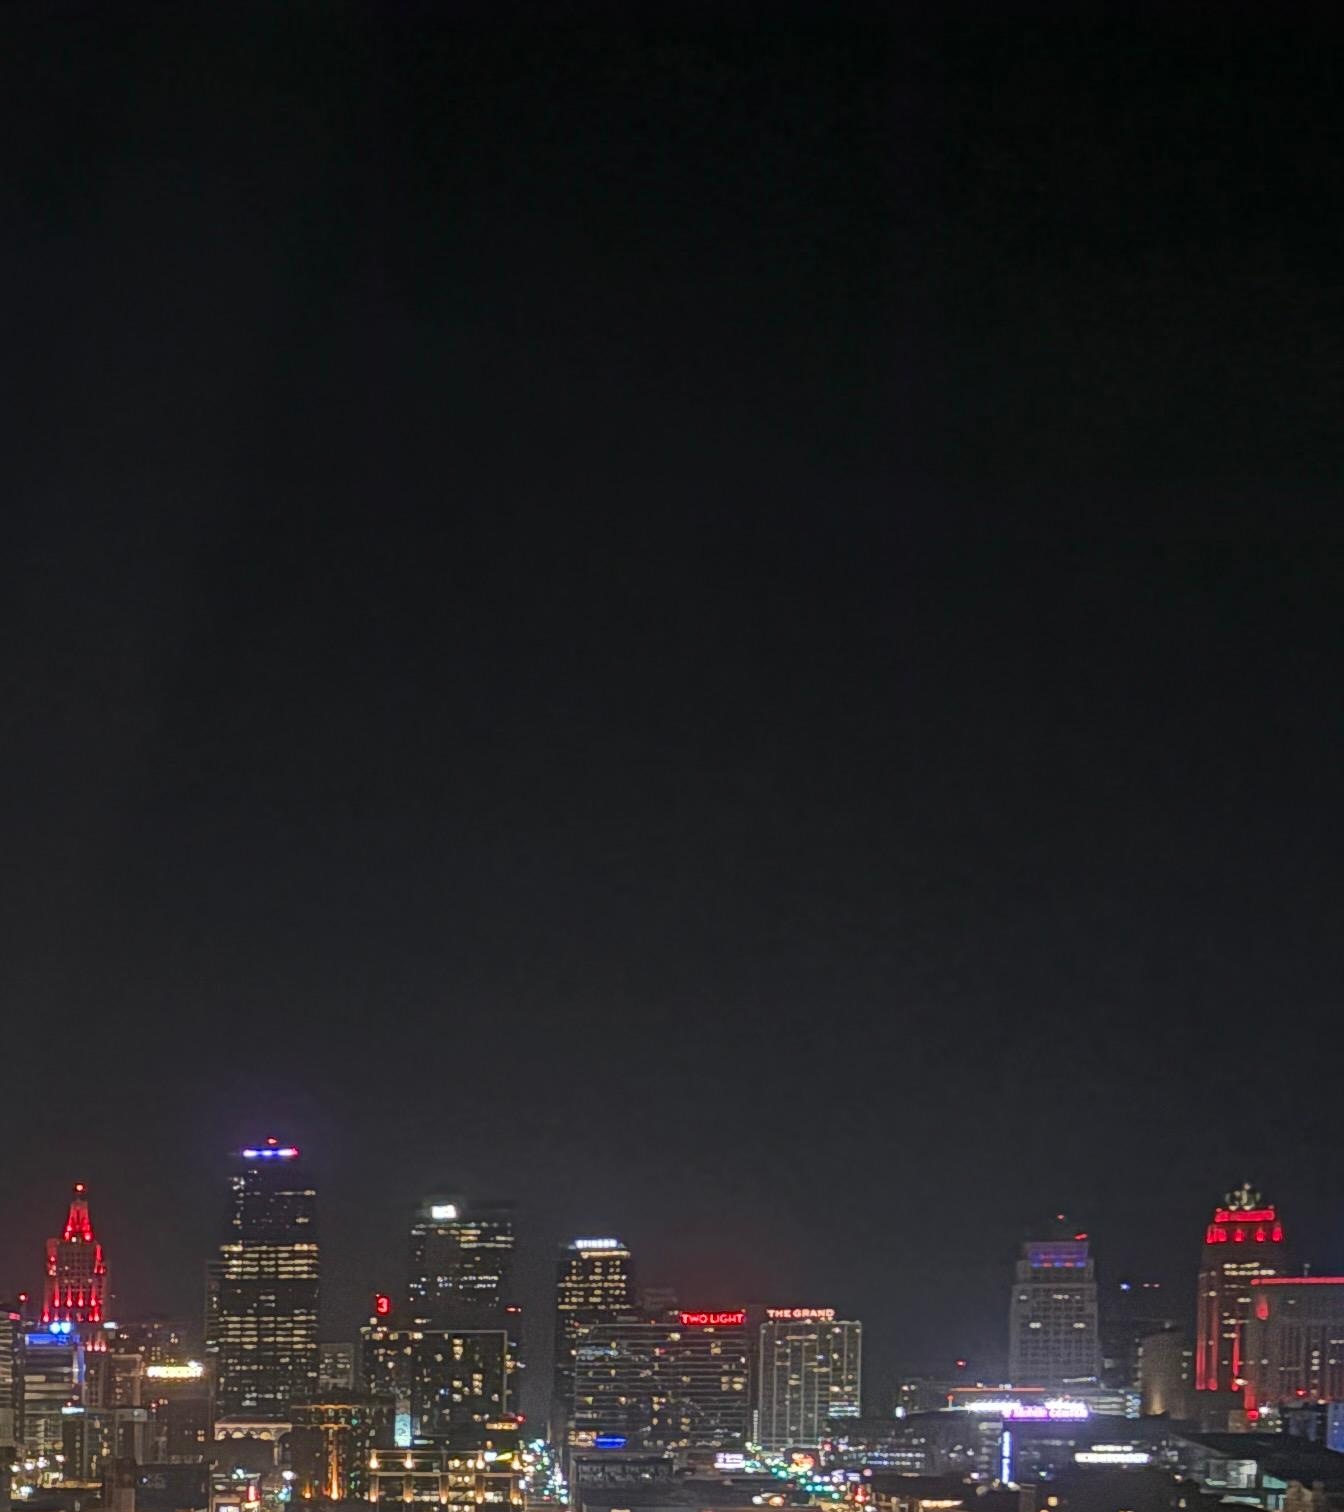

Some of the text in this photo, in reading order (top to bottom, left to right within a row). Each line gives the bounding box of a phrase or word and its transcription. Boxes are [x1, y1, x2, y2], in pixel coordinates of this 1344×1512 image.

[680, 1311, 745, 1324] TWO LIGHT
[766, 1308, 836, 1318] THE GRAND
